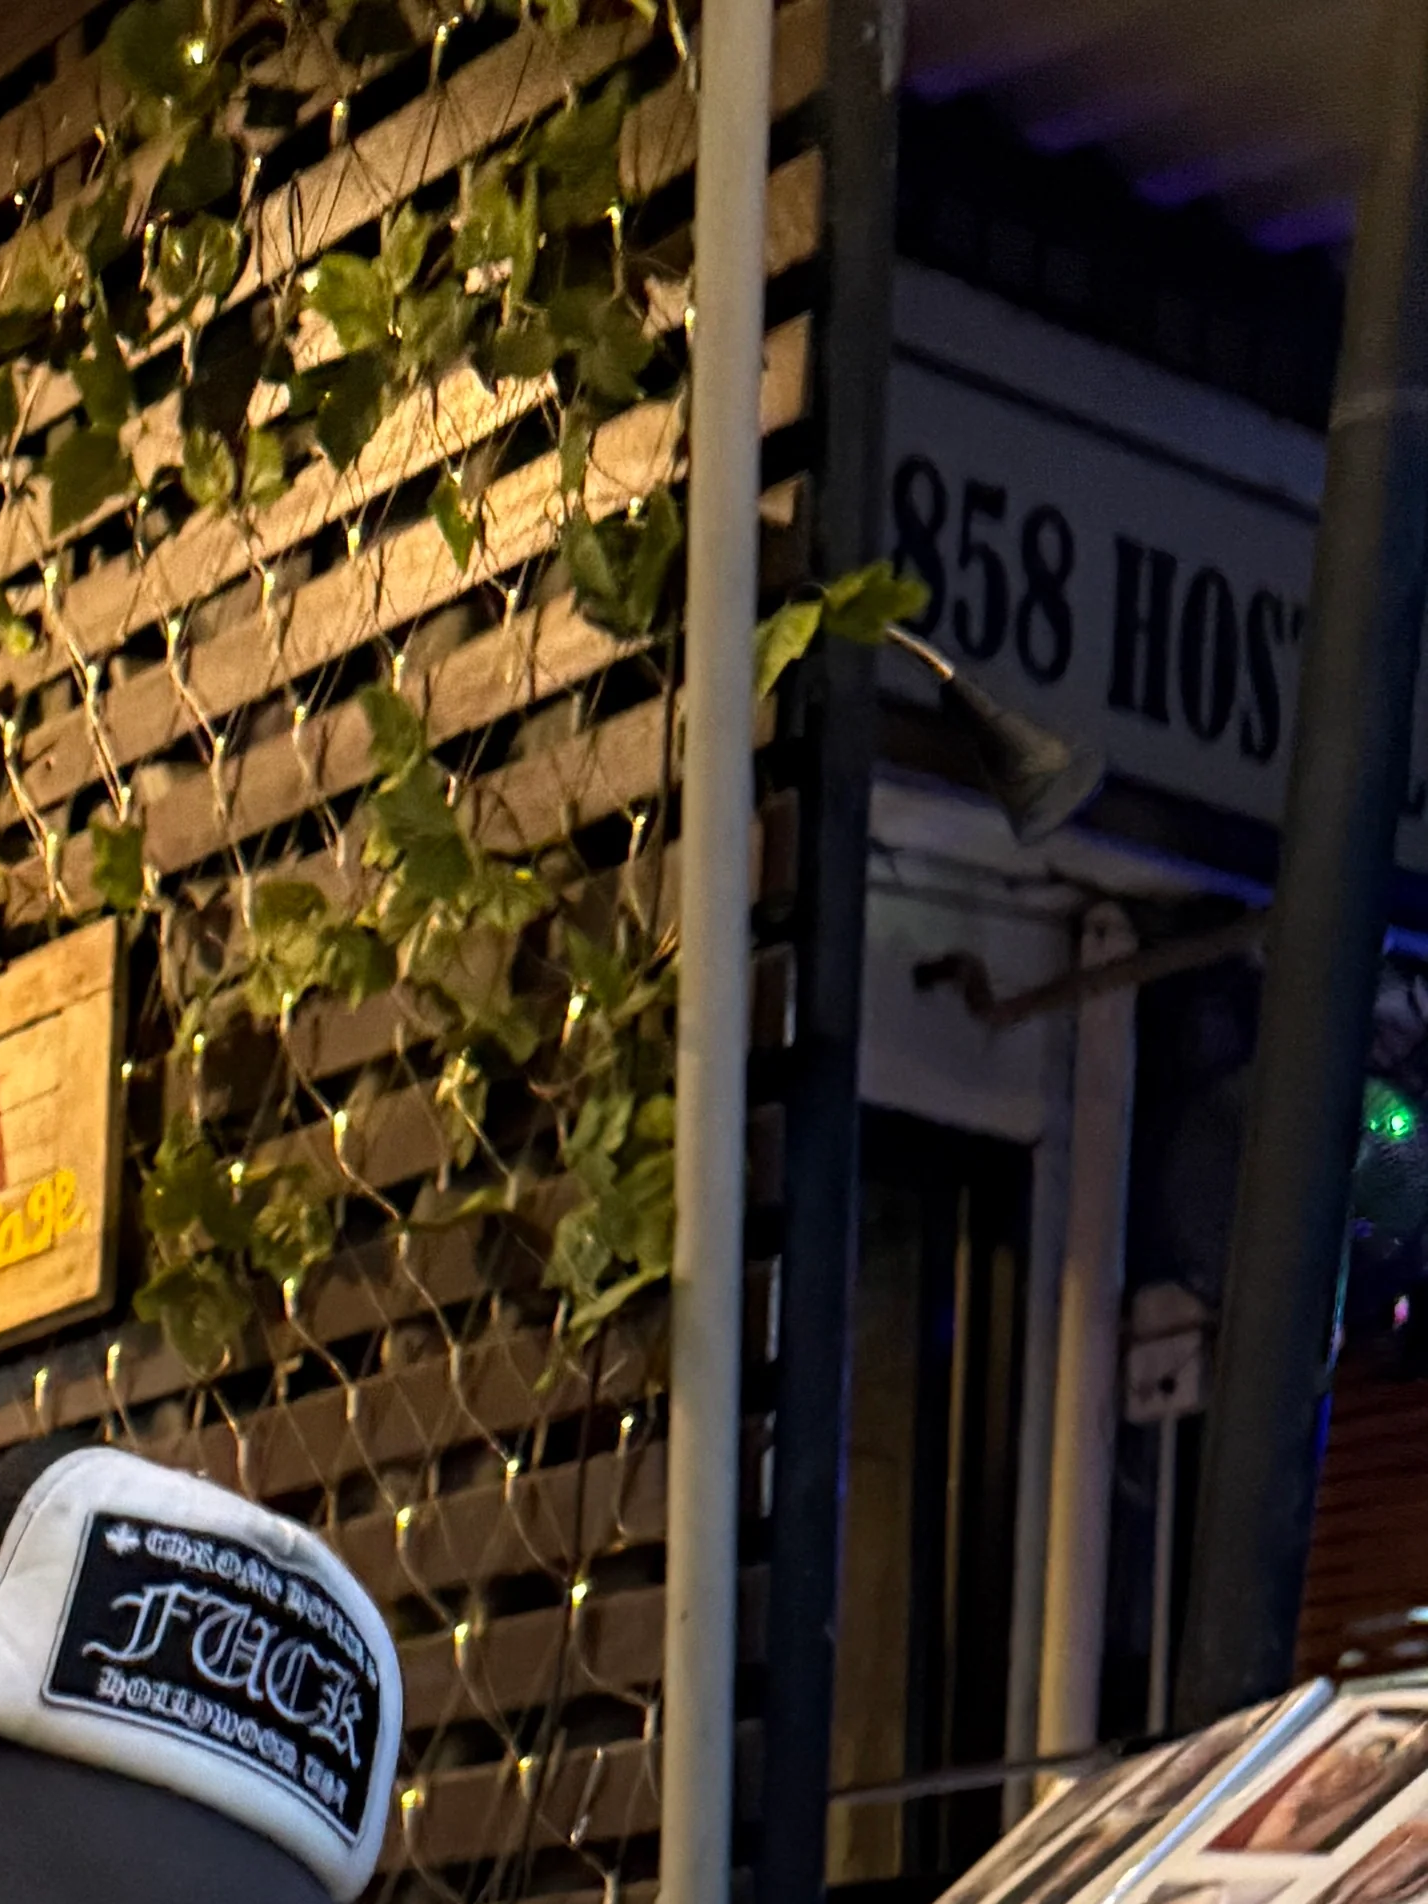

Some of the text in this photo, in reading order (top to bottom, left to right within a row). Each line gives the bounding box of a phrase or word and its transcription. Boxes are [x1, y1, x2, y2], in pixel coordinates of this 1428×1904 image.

[890, 454, 1306, 768] 858 HOS
[81, 1583, 363, 1770] FUCK
